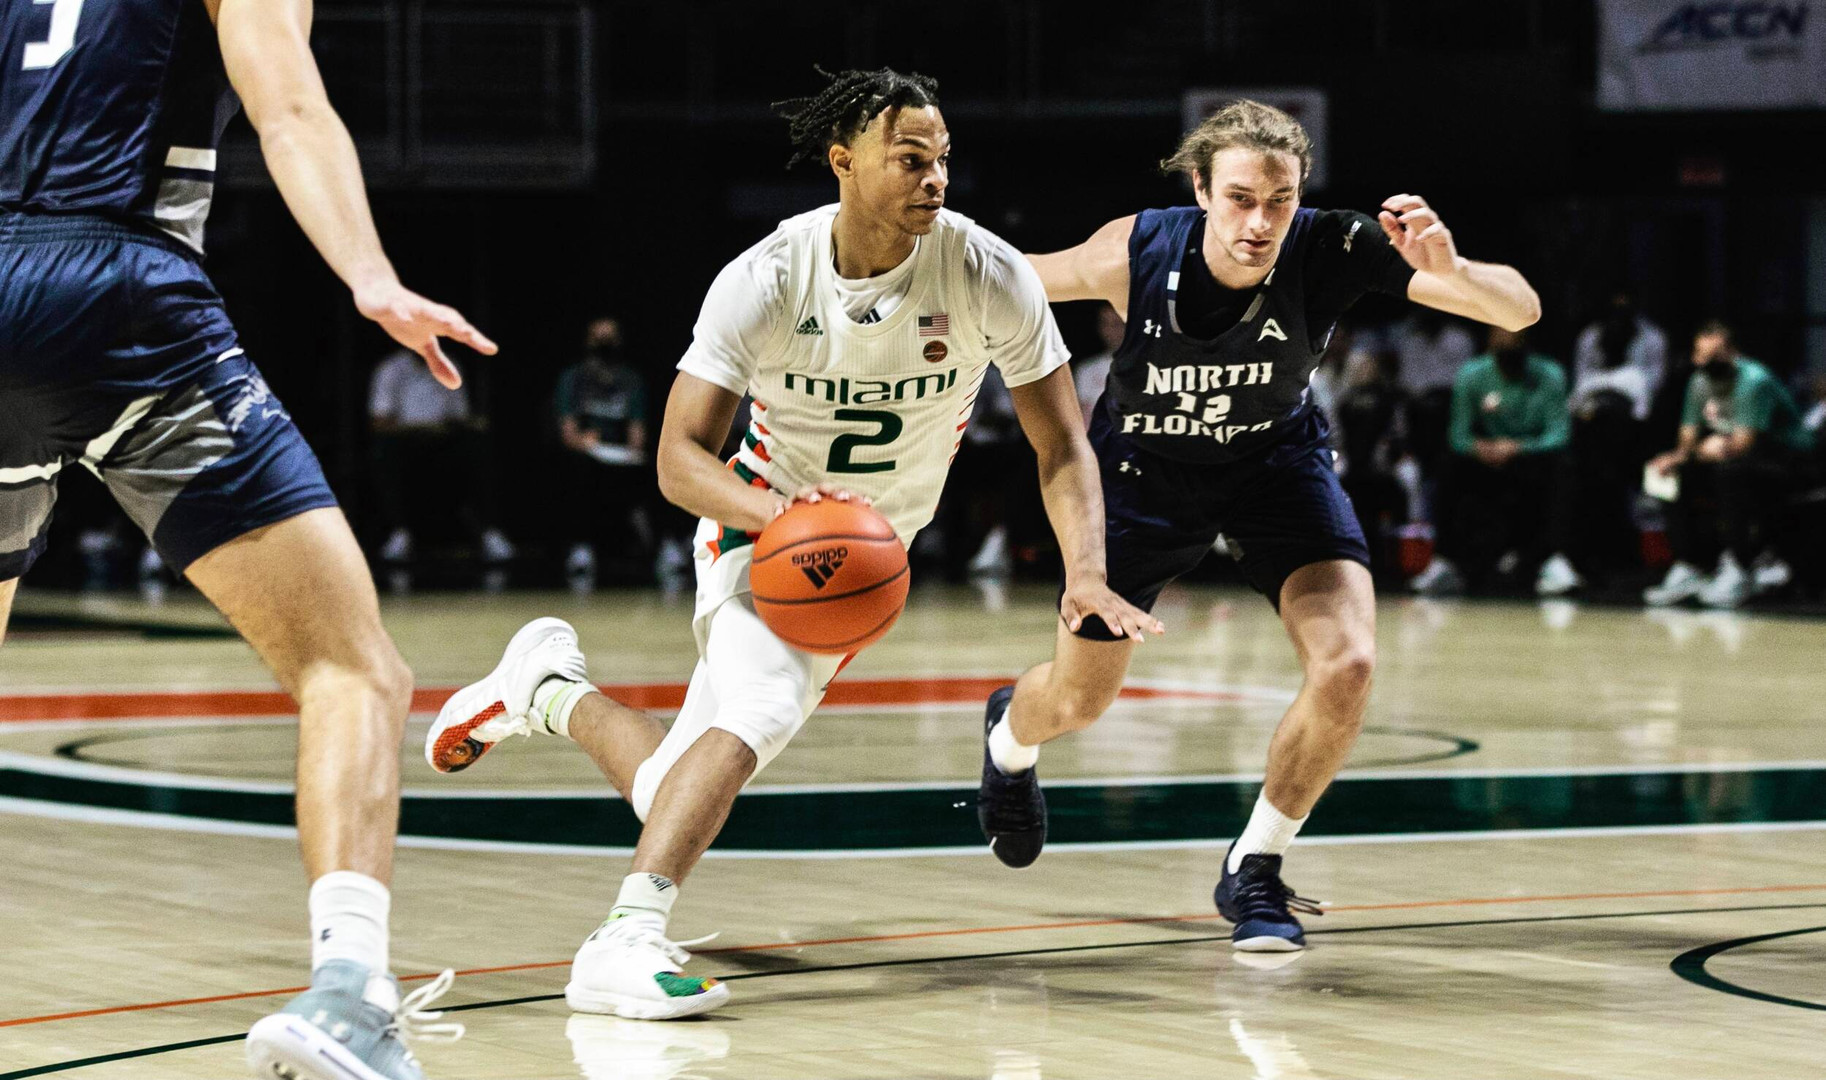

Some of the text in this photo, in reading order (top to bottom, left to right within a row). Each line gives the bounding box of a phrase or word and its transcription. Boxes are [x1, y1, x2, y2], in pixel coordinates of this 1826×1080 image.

[1142, 362, 1273, 395] NORTH
[1175, 391, 1232, 424] 12
[826, 408, 904, 474] 2
[791, 547, 849, 567] adidas
